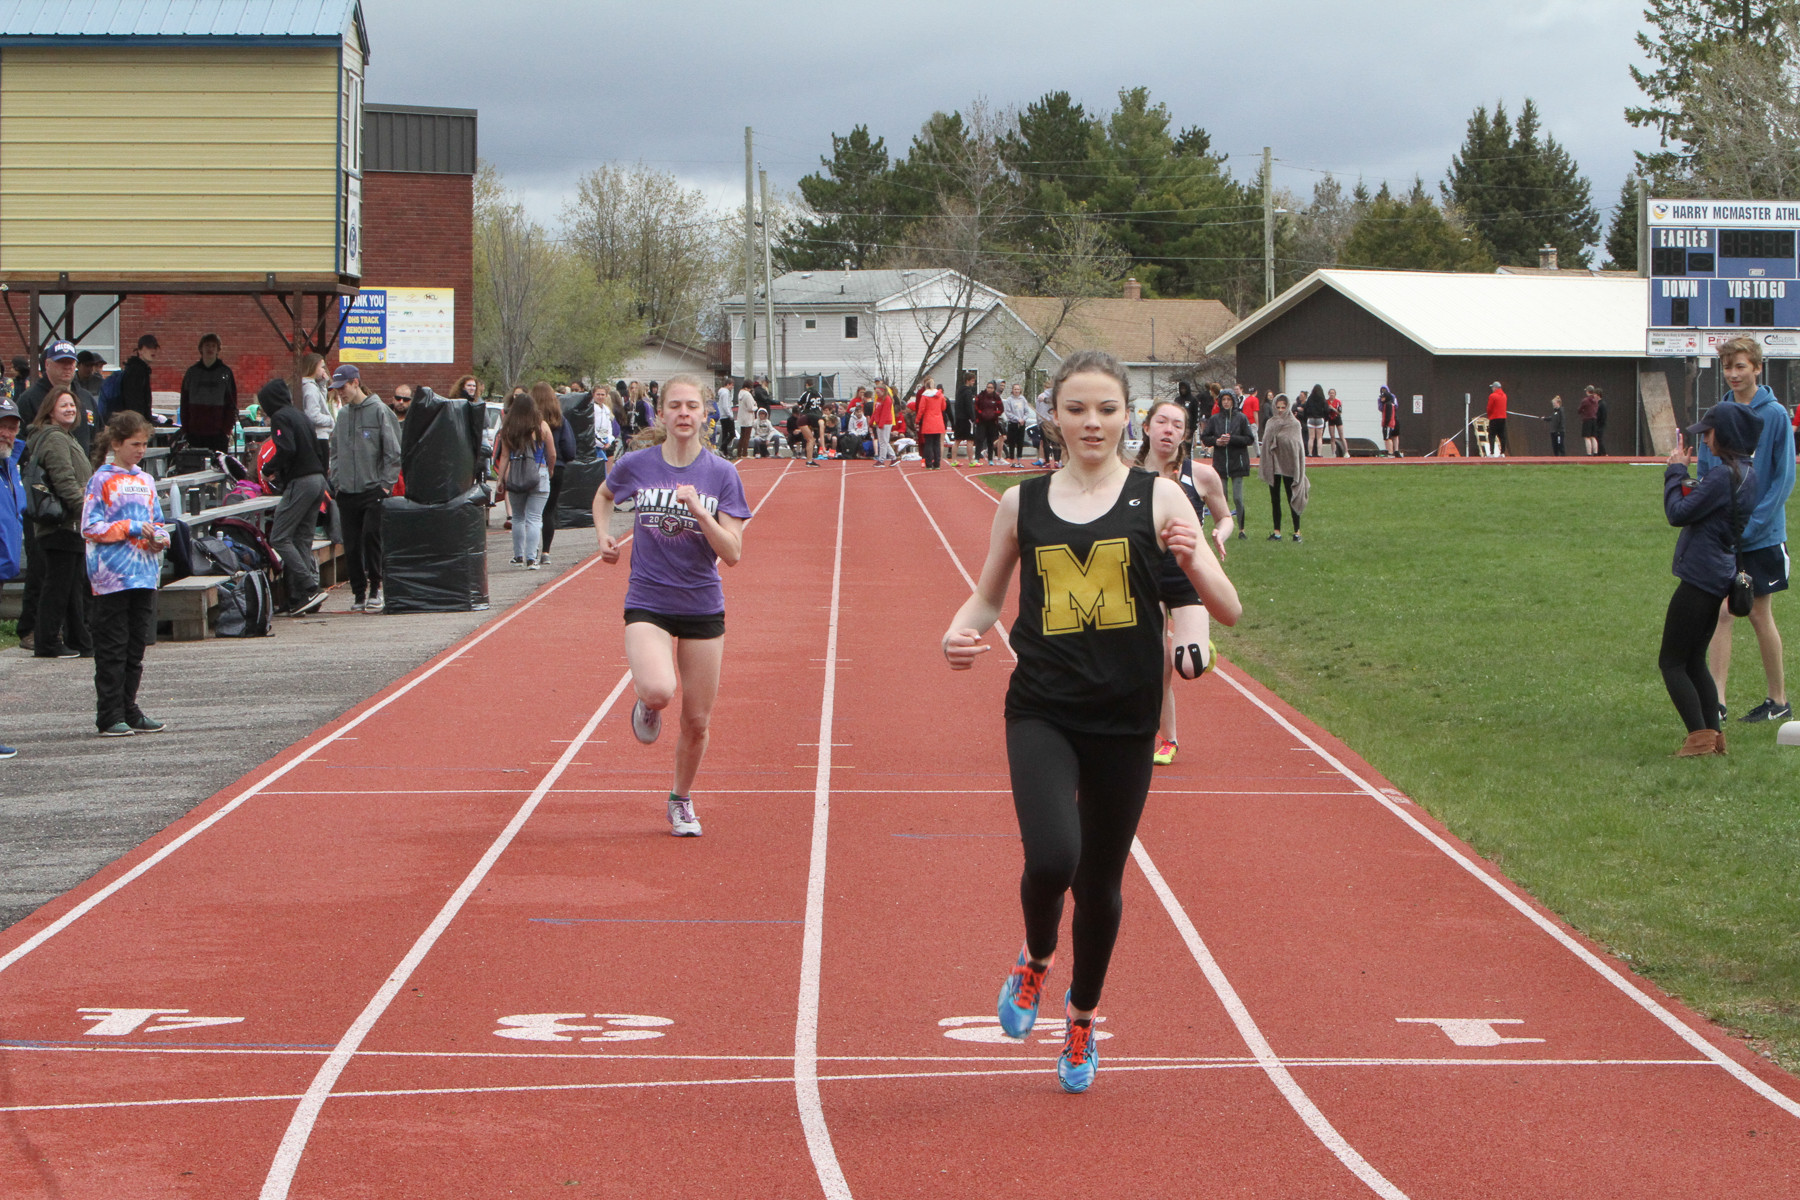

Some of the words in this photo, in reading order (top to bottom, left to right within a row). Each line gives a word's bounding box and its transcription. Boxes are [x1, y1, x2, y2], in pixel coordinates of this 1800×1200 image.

[1672, 206, 1708, 219] HARRY
[1713, 206, 1771, 220] MCMASTER
[1775, 207, 1800, 221] ATHL
[1660, 229, 1708, 248] EAGLES
[1662, 280, 1698, 298] DOWN
[1728, 280, 1750, 298] YDS
[1753, 281, 1767, 298] TO
[1769, 281, 1786, 299] GO
[369, 295, 384, 307] YOU
[360, 316, 379, 324] TRACK
[346, 326, 381, 334] RENOVATION
[344, 336, 369, 344] PROJECT
[636, 488, 719, 516] ONTAIO
[684, 520, 694, 528] 19
[1035, 537, 1138, 636] M
